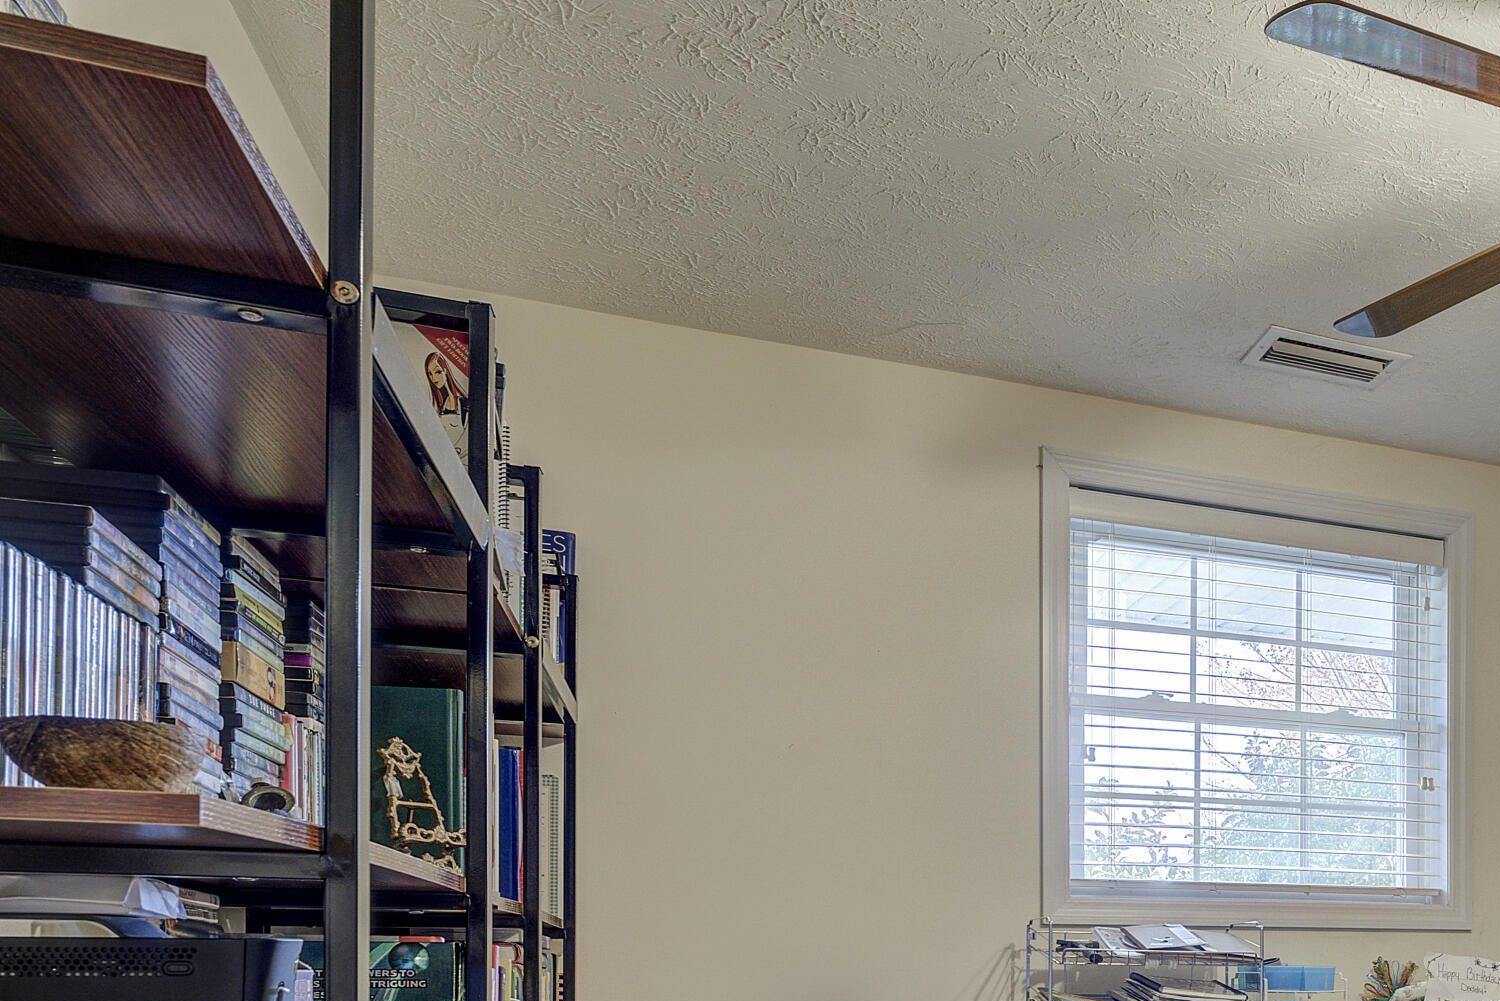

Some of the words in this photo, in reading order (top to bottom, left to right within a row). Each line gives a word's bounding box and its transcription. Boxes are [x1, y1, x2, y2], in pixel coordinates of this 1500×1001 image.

[399, 969, 415, 977] TO
[1437, 962, 1460, 981] Happy
[1466, 967, 1500, 984] Birthday
